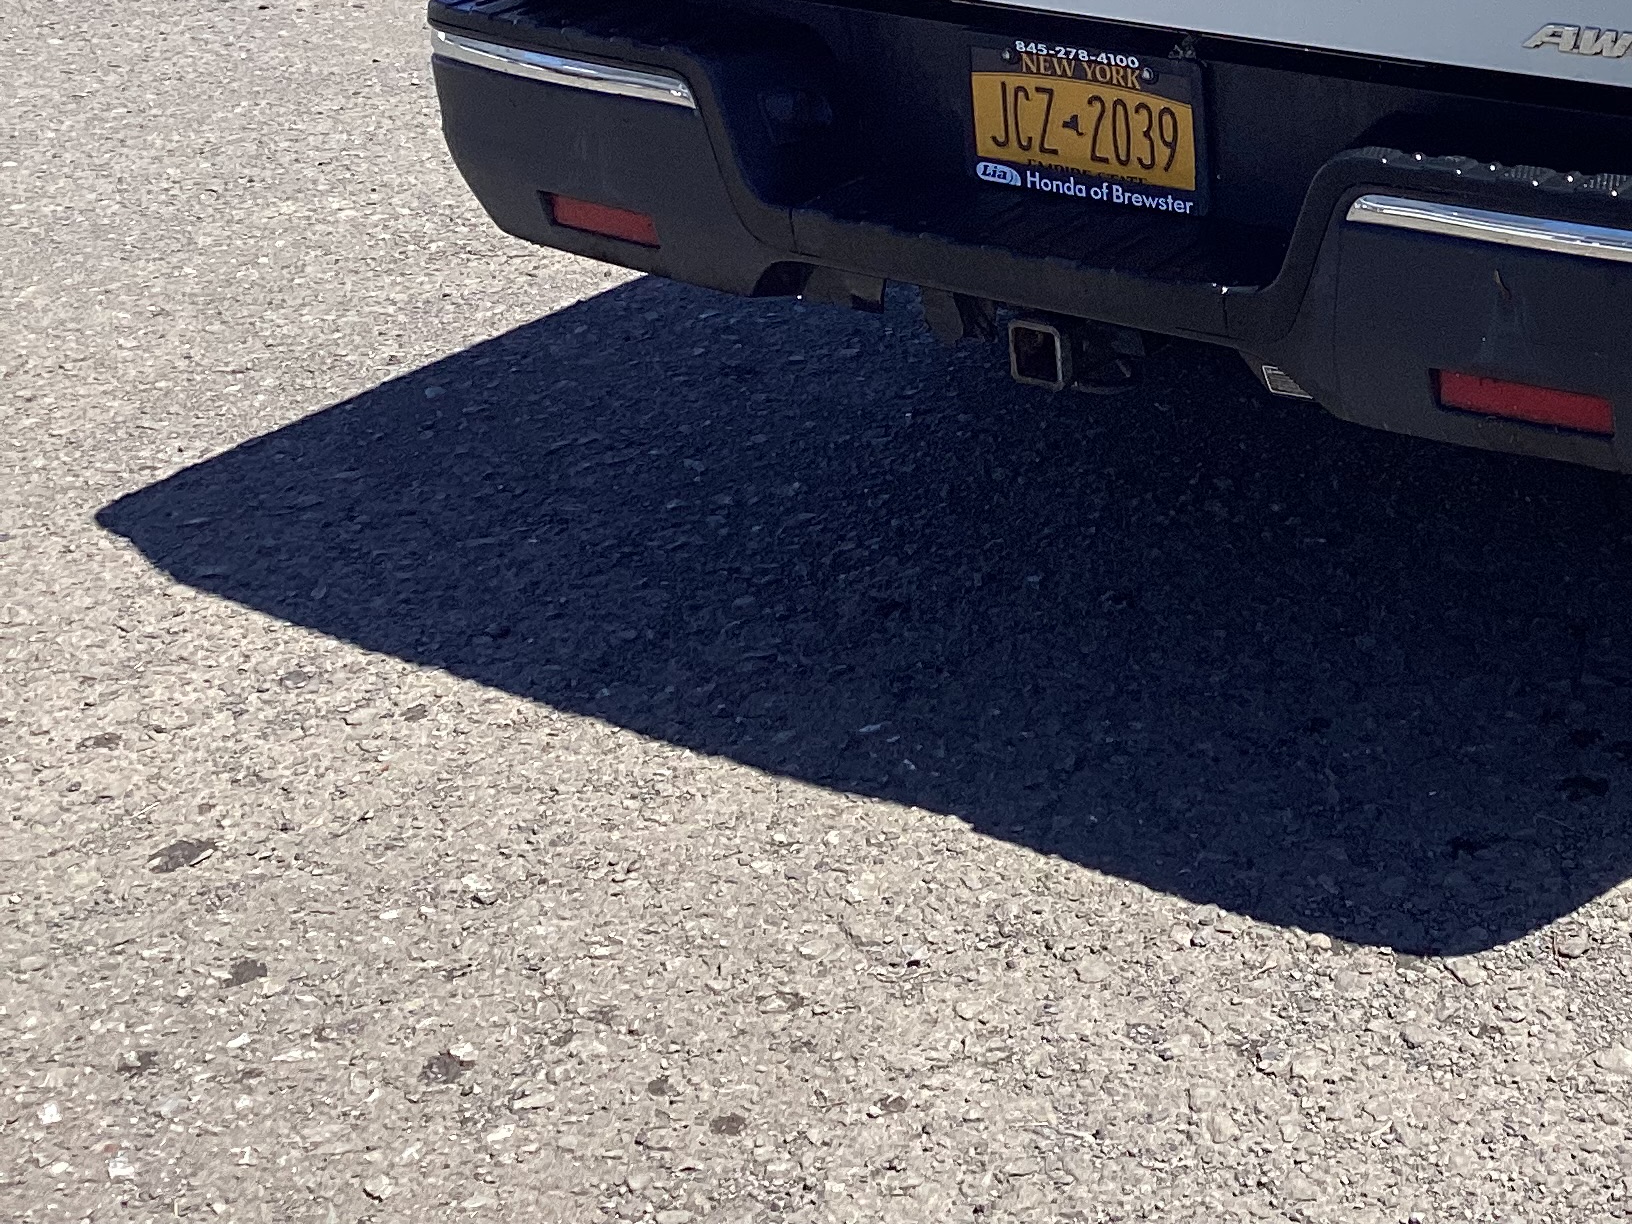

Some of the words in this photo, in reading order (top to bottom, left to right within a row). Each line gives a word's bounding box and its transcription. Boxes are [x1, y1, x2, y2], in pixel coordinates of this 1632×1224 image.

[1015, 40, 1140, 68] 845-278-4100
[1020, 52, 1076, 78] NEW
[1081, 61, 1140, 89] YORK
[991, 81, 1059, 156] JCZ
[1087, 94, 1179, 172] 2039
[1026, 170, 1087, 197] Honda
[1090, 182, 1109, 201] of
[1112, 184, 1194, 214] Brewster
